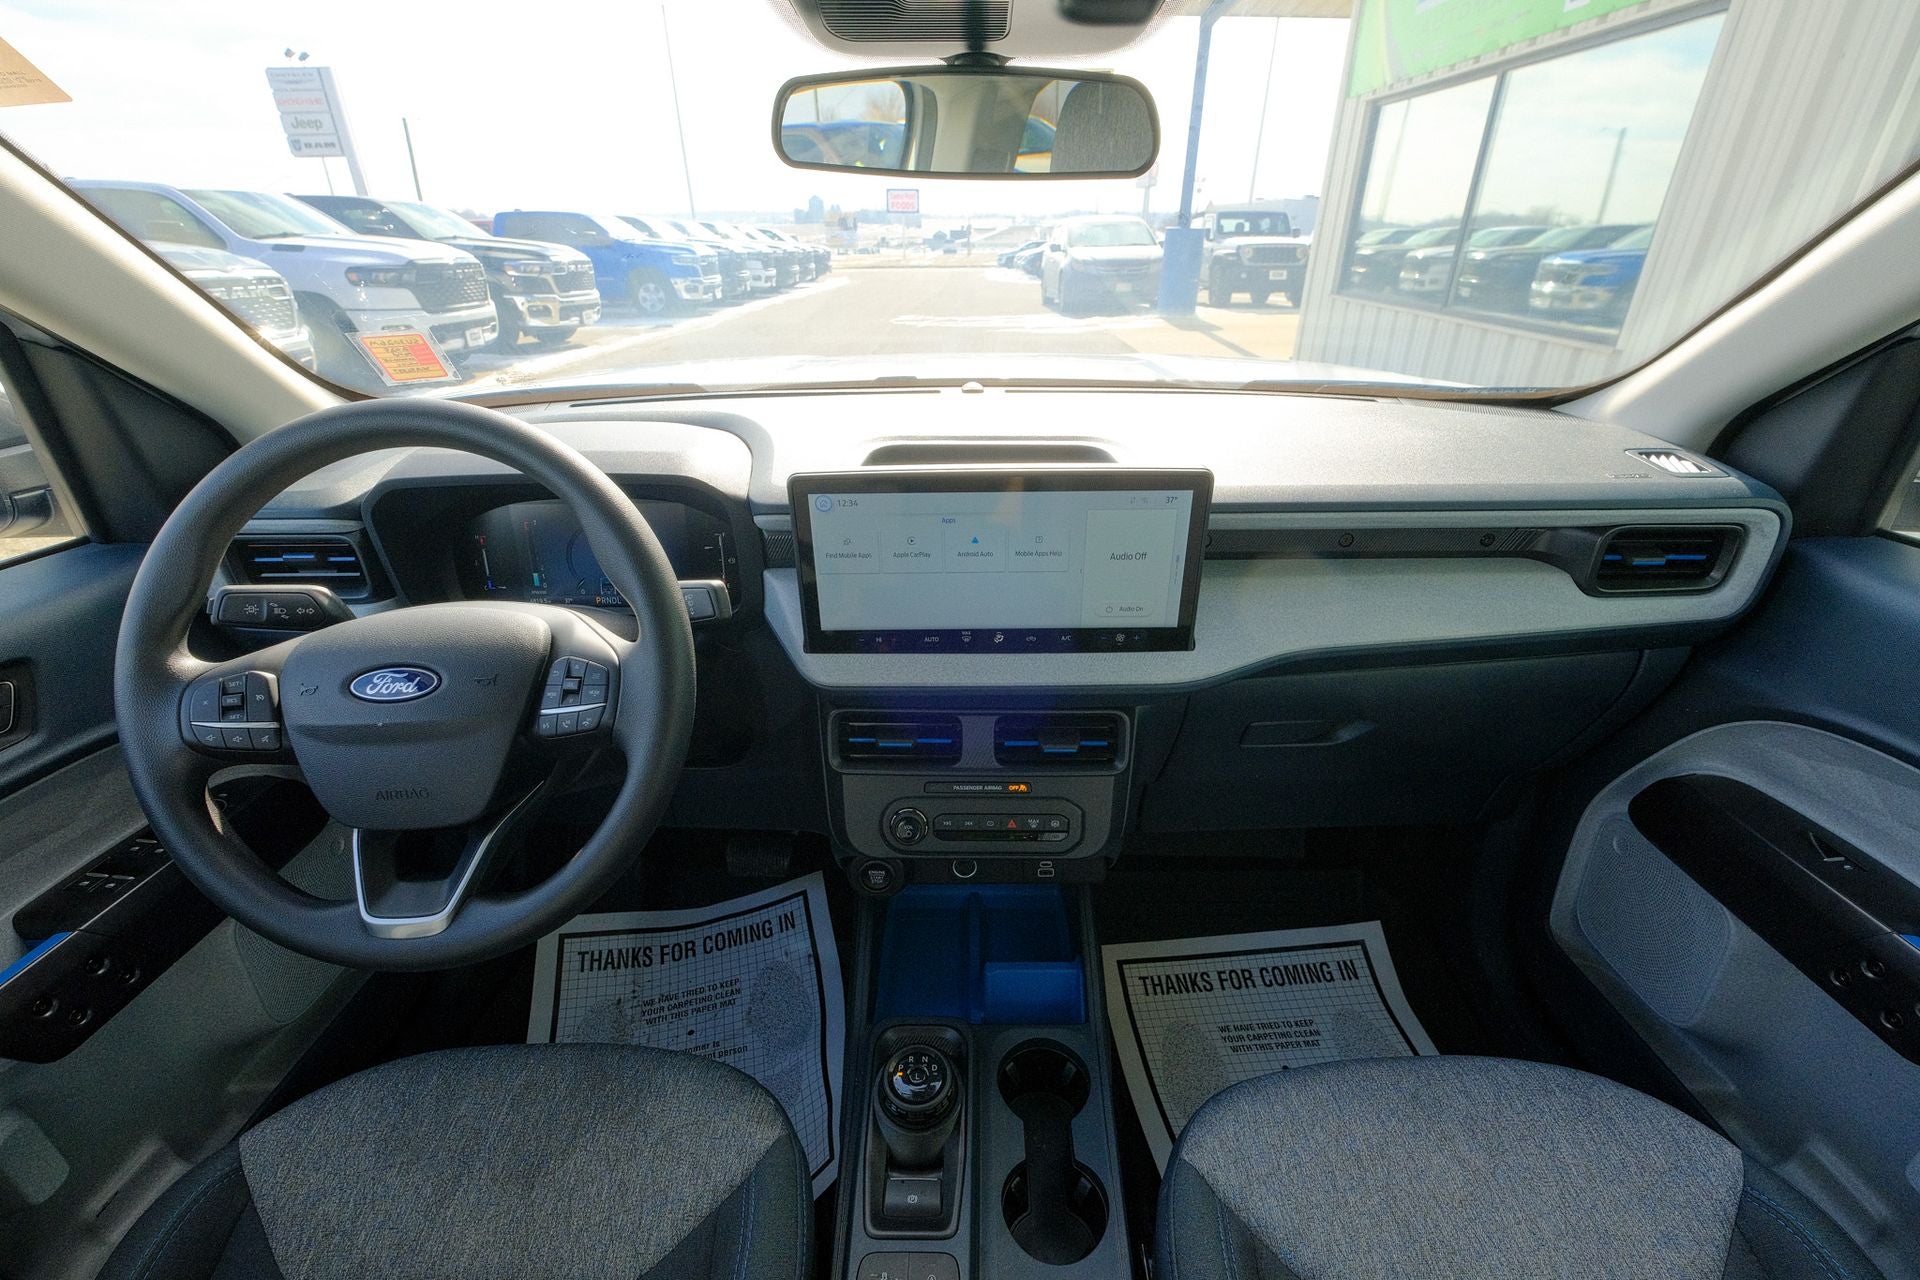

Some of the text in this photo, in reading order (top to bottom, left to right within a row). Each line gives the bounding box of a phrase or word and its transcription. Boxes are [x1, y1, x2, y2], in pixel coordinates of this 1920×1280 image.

[291, 115, 323, 131] Jeep
[838, 499, 858, 507] 12:34
[942, 517, 956, 525] Apps
[1110, 552, 1147, 561] Audio Off
[366, 672, 421, 694] Ford
[375, 786, 430, 801] AIRBAG
[577, 911, 796, 973] THANKS FOR COMING IN
[1138, 959, 1360, 997] THANKS FOR COMING IN
[642, 978, 740, 1008] WE HAVE TRIED TO KEEP
[641, 988, 741, 1017] YOUR CARPETING CLEAN
[645, 998, 737, 1025] WITH THIS PAPER MAT
[1219, 1019, 1314, 1033] WE HAVE TRIED TO KEEP
[1221, 1028, 1322, 1043] YOUR CARPETING CLEAN
[718, 1045, 748, 1059] person
[1230, 1039, 1320, 1053] WITH THIS PAPER MAT
